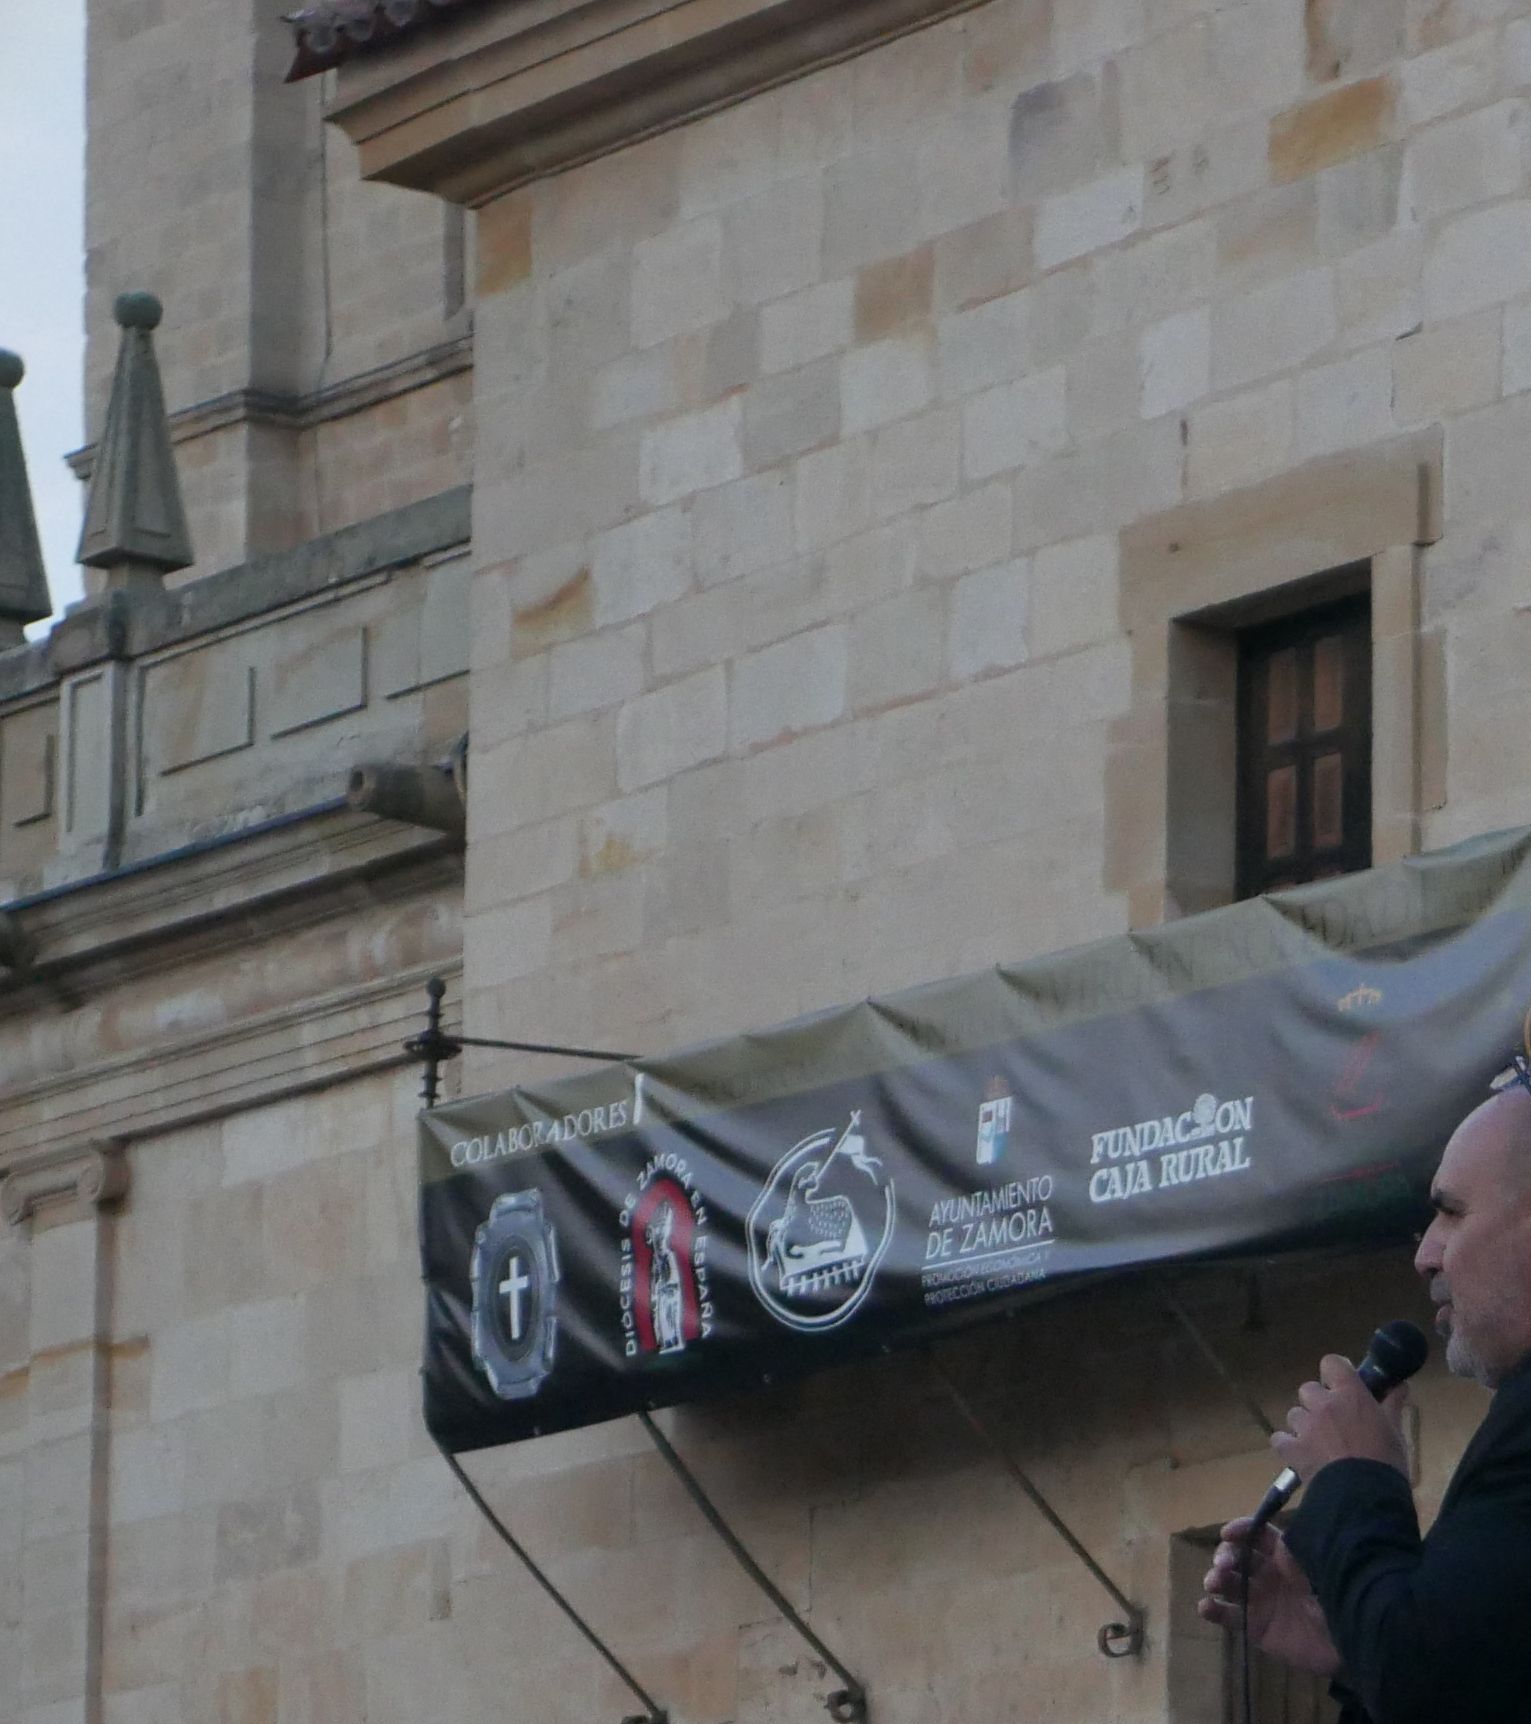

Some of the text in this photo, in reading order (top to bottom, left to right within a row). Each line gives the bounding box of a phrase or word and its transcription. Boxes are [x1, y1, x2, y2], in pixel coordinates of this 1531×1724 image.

[450, 1100, 627, 1167] COLABORADORES
[637, 1153, 694, 1189] ZAMORA
[1088, 1136, 1251, 1204] CAJA RURAL
[619, 1192, 637, 1227] DE
[691, 1190, 708, 1225] EN
[929, 1175, 1053, 1228] AYUNTAMIENTO
[925, 1207, 1053, 1260] DE ZAMORA
[694, 1236, 714, 1337] ESPAÑA
